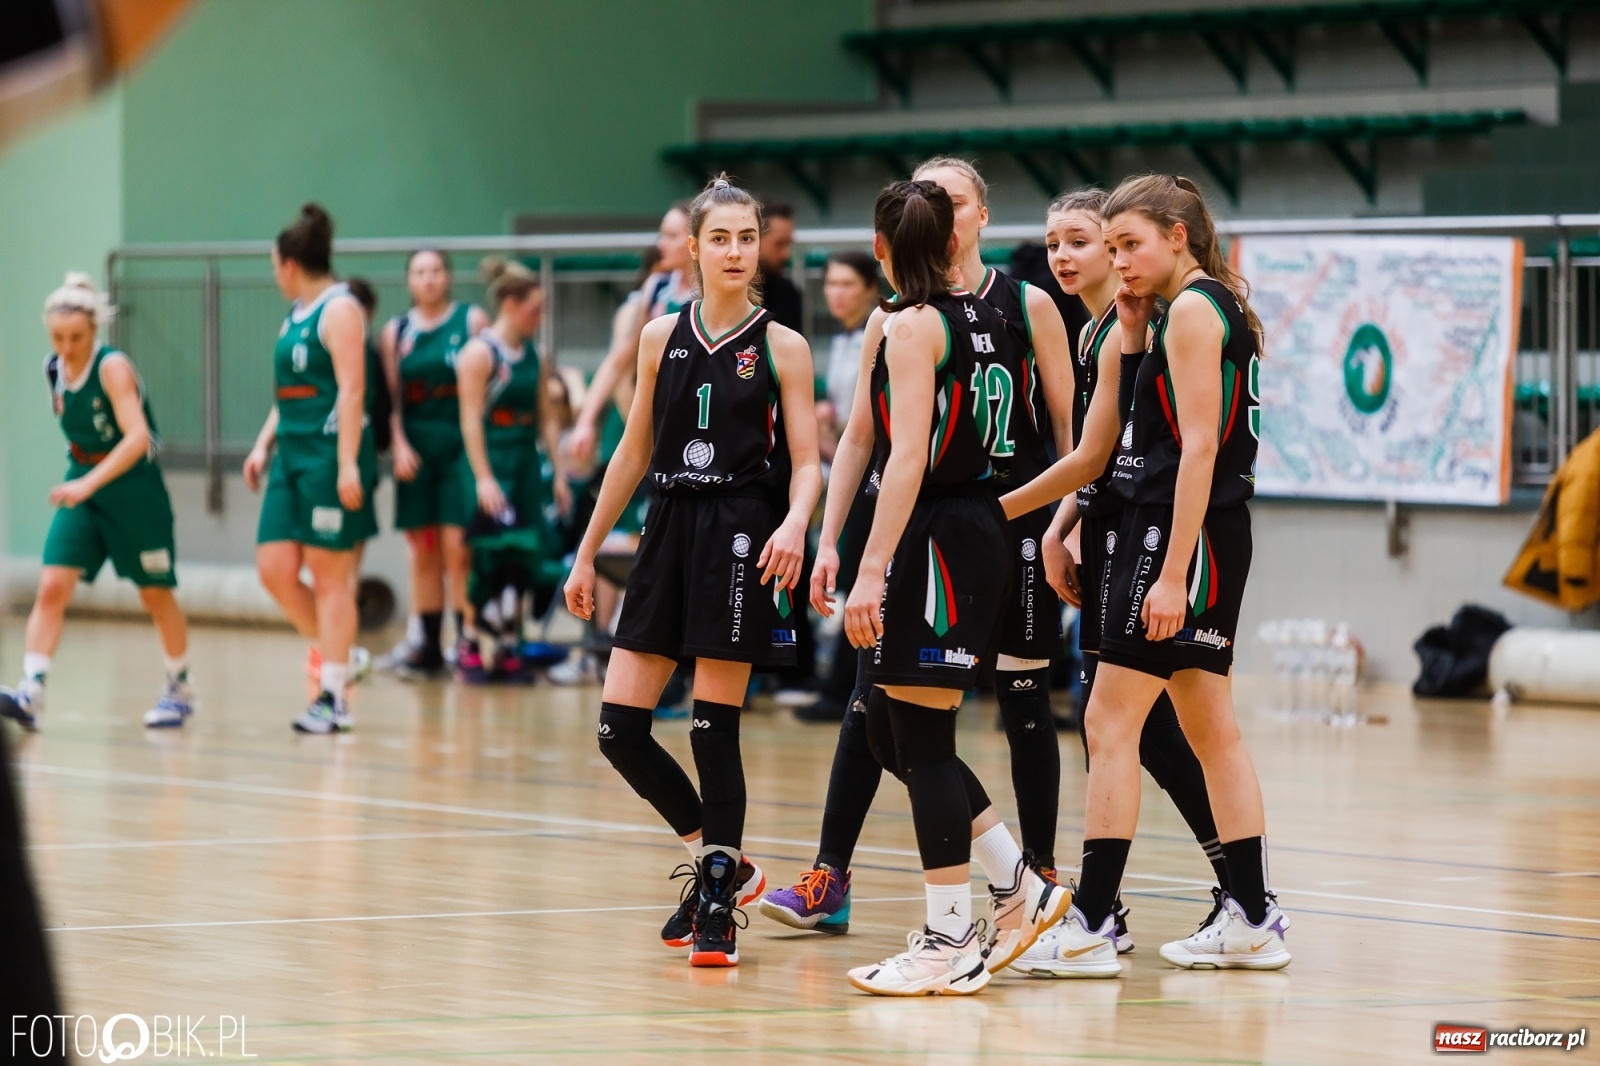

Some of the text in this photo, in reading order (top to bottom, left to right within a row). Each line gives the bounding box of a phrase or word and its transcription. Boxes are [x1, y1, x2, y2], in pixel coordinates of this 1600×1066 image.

[669, 348, 689, 359] UFO
[696, 382, 712, 430] 1
[969, 361, 1016, 457] 12
[731, 563, 745, 642] CTL LOGISTICS
[1025, 566, 1035, 641] CTL LOGISTICS
[1125, 556, 1153, 635] CTL LOGISTICS
[1193, 627, 1228, 650] Haldex
